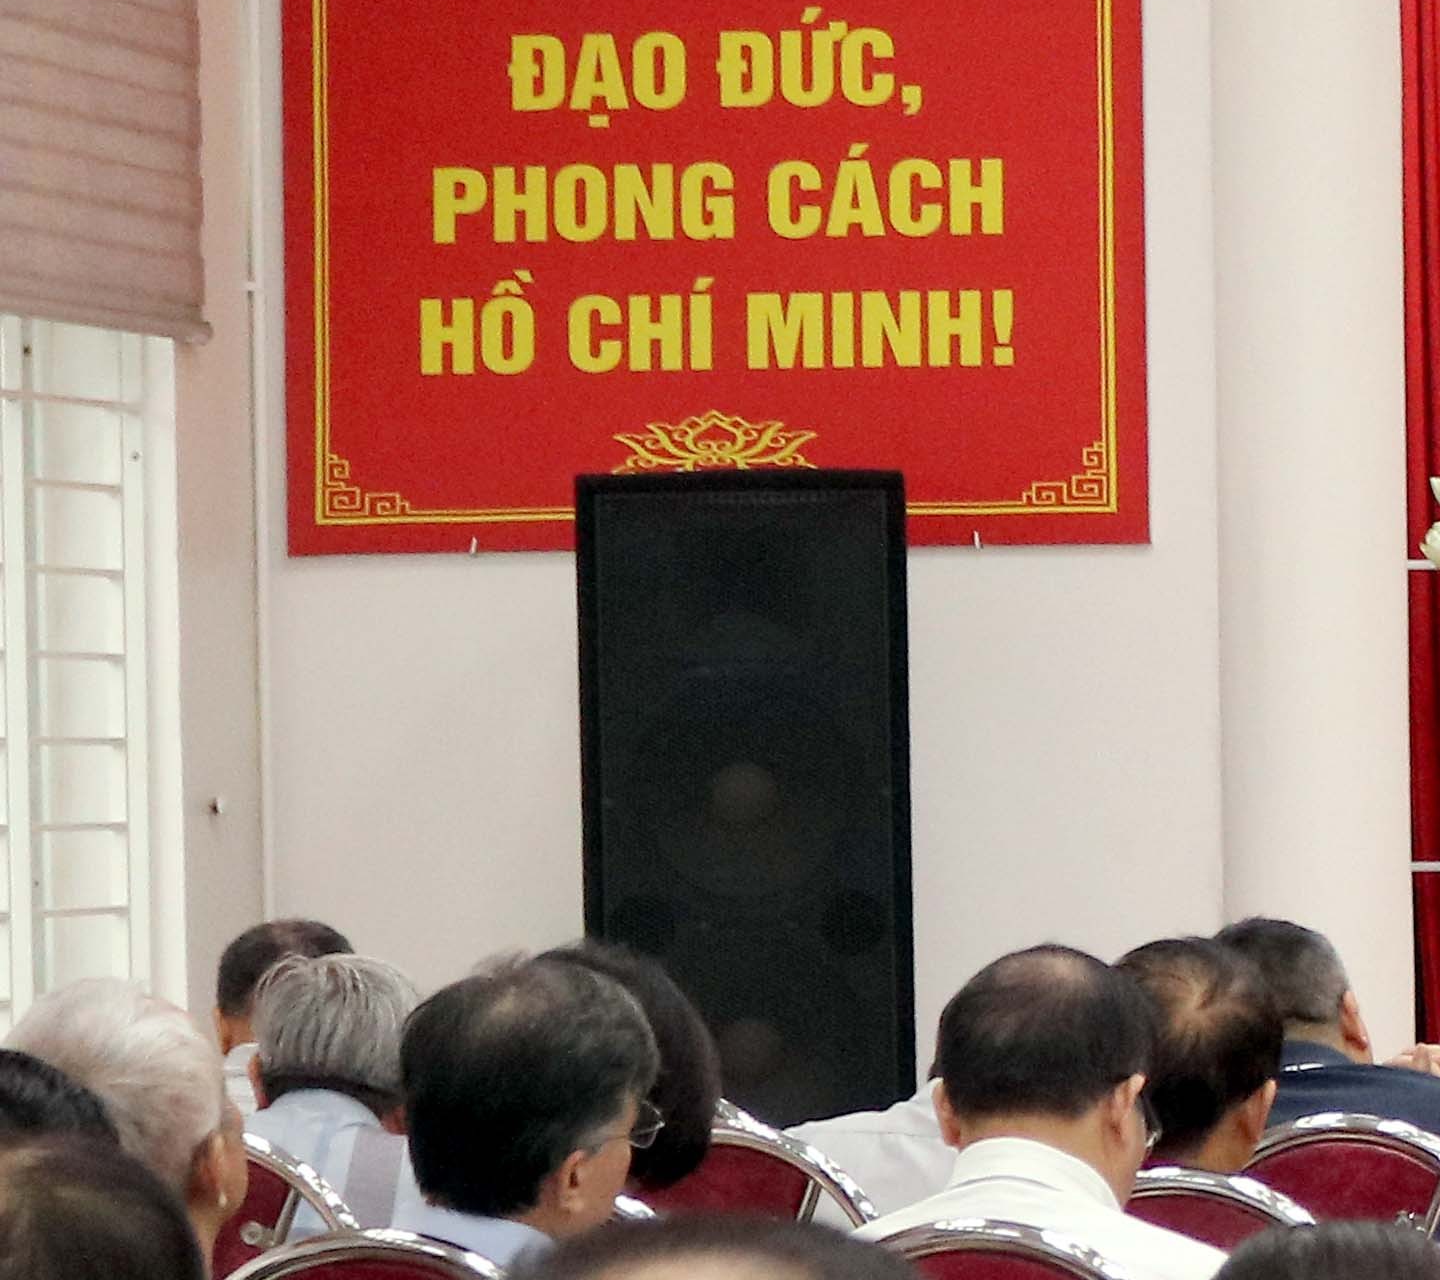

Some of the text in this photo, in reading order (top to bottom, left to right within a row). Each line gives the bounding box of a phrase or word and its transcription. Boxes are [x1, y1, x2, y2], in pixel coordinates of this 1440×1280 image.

[509, 7, 921, 127] ĐẠO ĐỨC,
[434, 144, 1003, 243] PHONG CÁCH
[421, 271, 1013, 374] HỒ CHÍ MINH!
